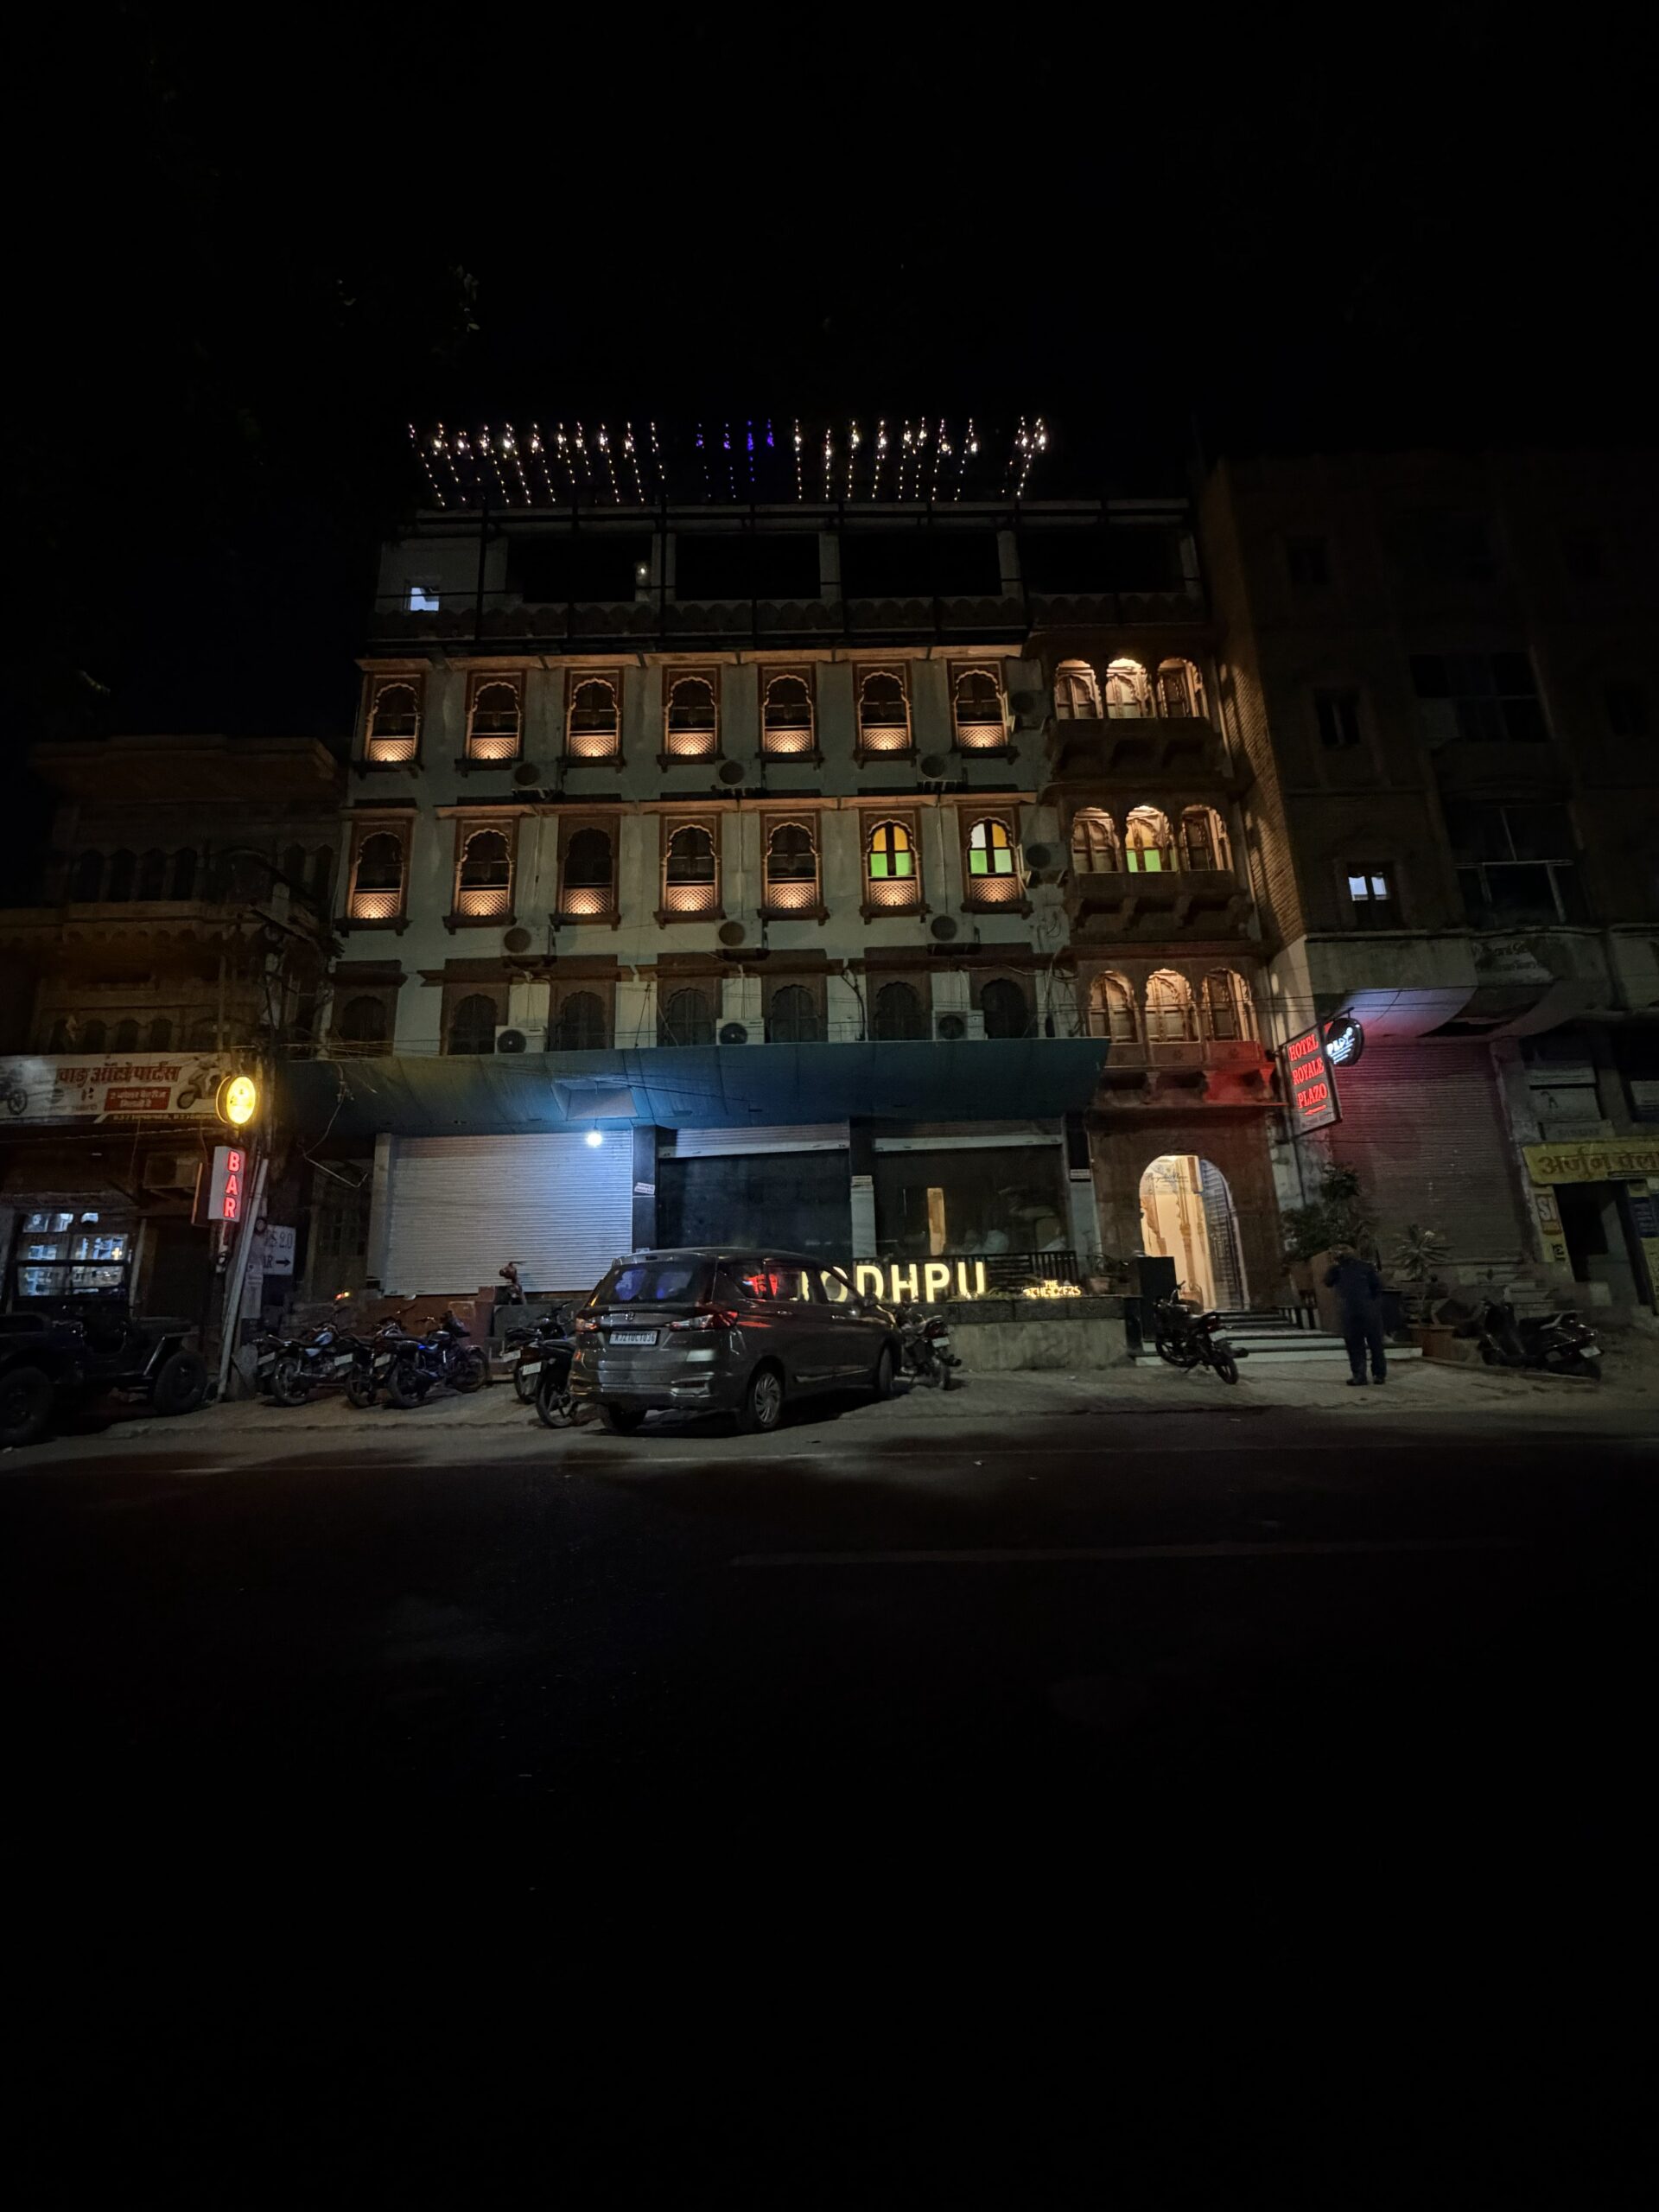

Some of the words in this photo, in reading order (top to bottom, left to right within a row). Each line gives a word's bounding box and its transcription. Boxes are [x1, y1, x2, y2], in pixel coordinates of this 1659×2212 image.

[1288, 1033, 1319, 1061] HOTEL
[1292, 1057, 1325, 1086] ROYALE
[1297, 1083, 1328, 1109] PLAZO
[223, 1150, 241, 1218] BAR
